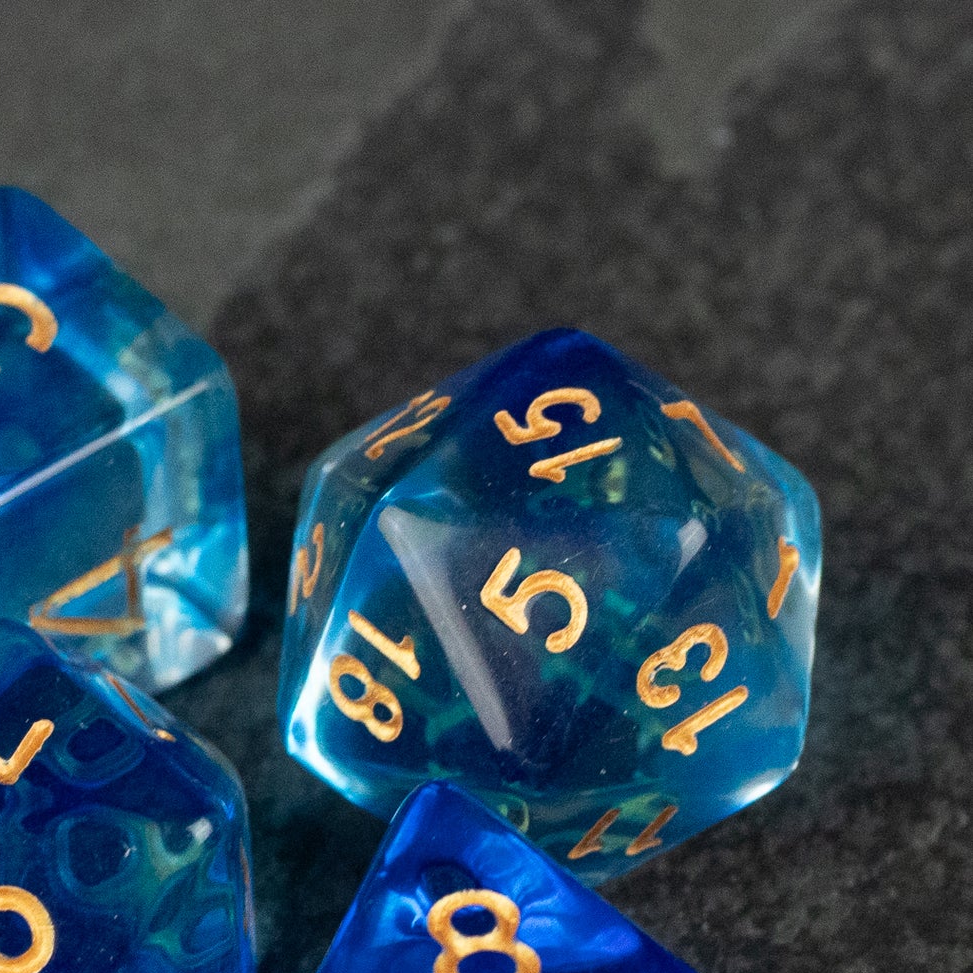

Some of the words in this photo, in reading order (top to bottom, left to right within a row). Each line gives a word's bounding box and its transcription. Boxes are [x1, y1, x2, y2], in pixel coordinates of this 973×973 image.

[493, 386, 624, 484] 15
[28, 524, 173, 637] 4
[479, 546, 589, 654] 5
[327, 609, 422, 743] 18
[635, 622, 750, 757] 13
